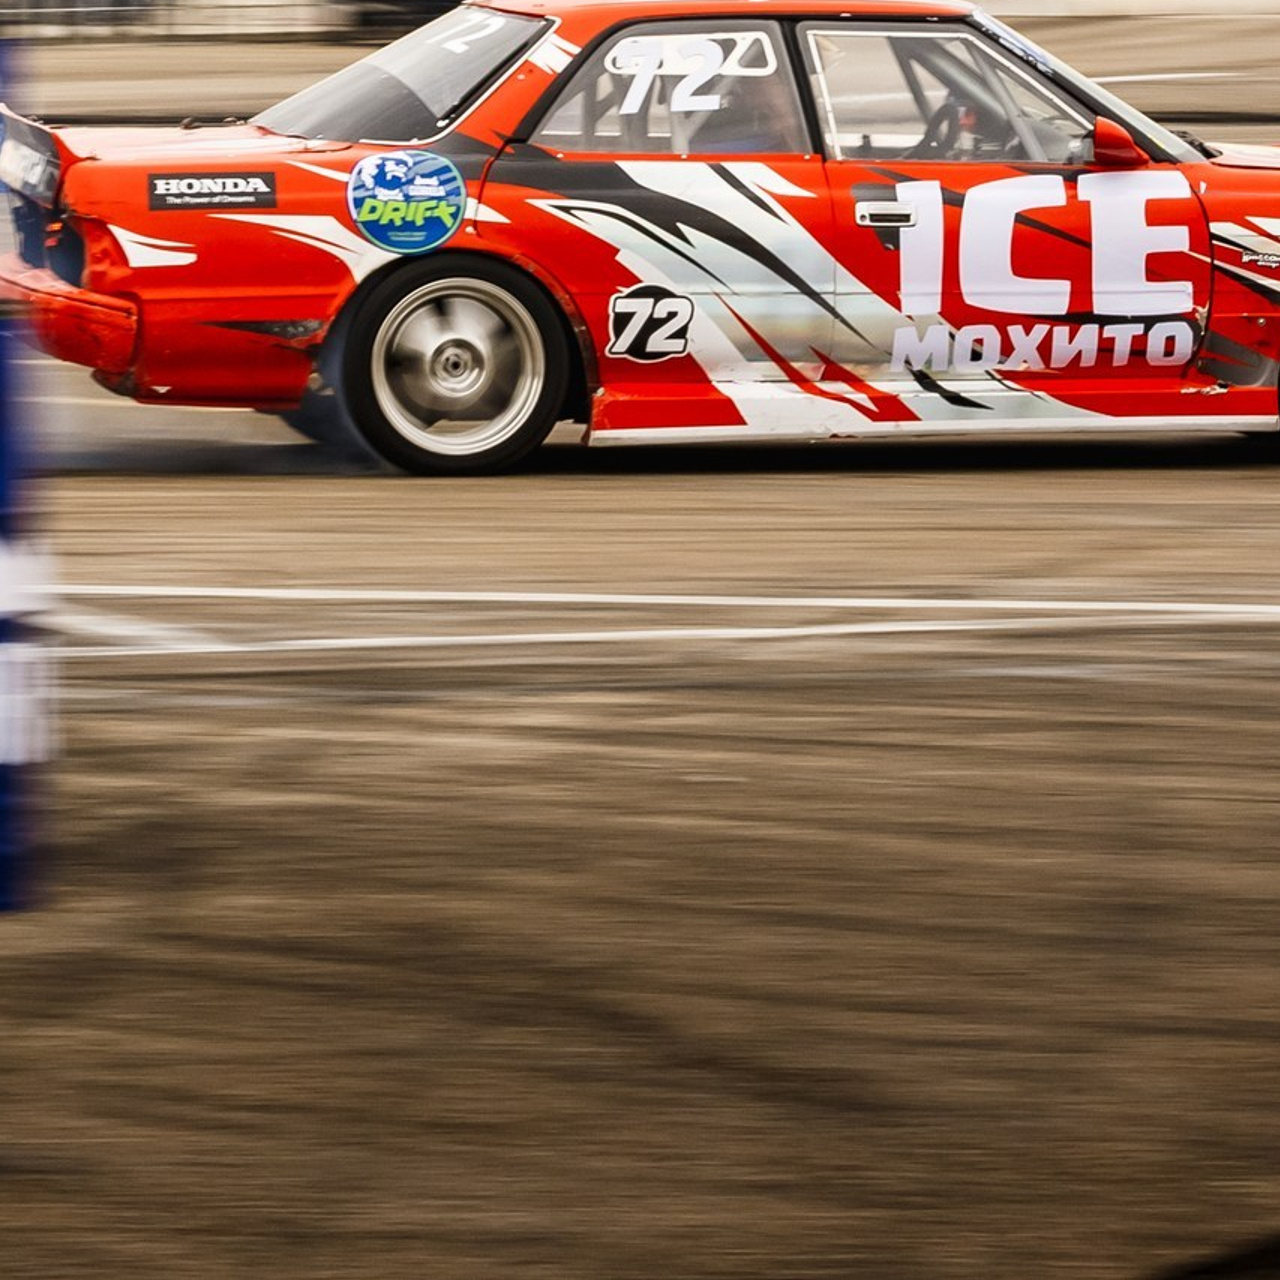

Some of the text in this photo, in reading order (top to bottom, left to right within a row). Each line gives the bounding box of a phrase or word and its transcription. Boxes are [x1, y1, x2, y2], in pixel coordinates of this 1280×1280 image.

[616, 38, 724, 114] 72
[153, 177, 271, 194] HONDA
[357, 197, 457, 228] DRIFT
[895, 170, 1194, 316] ICE
[610, 297, 693, 353] 72
[890, 321, 1194, 371] МОХИТО
